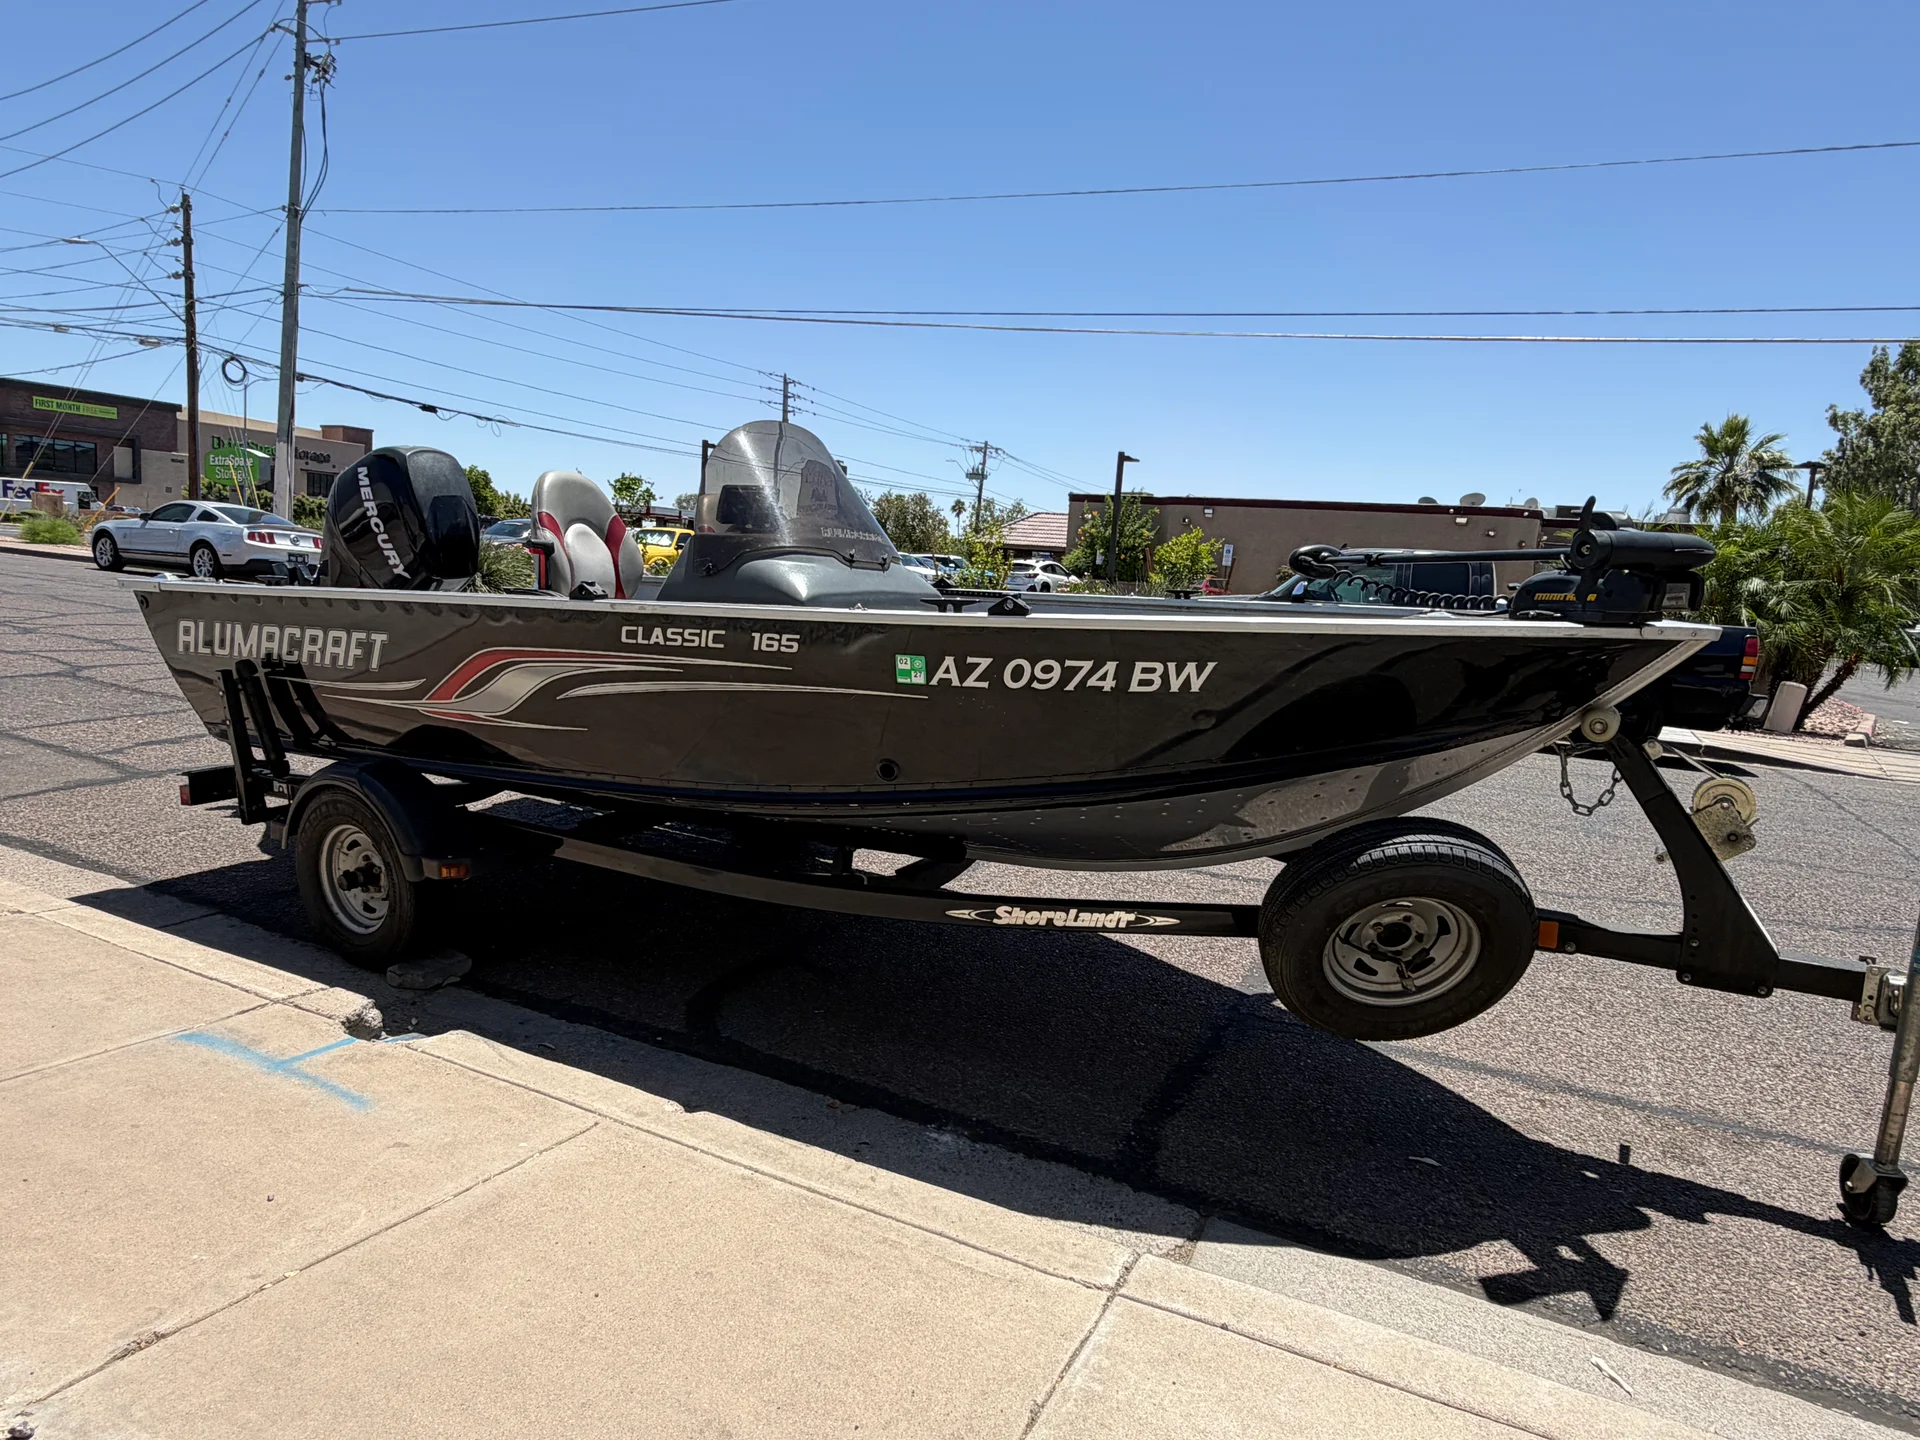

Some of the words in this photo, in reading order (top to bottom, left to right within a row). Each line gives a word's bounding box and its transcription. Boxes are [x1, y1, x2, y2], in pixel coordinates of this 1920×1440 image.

[35, 399, 55, 409] FIRST
[56, 401, 81, 413] MONTH
[215, 466, 248, 482] Storg
[357, 466, 411, 579] MERCURY
[177, 618, 388, 672] ALUMACRAFT
[620, 625, 726, 649] CLASSIC
[751, 632, 801, 653] 165
[899, 657, 909, 666] 02
[929, 656, 994, 689] AZ
[1003, 658, 1120, 692] 0974
[1127, 661, 1218, 693] BW
